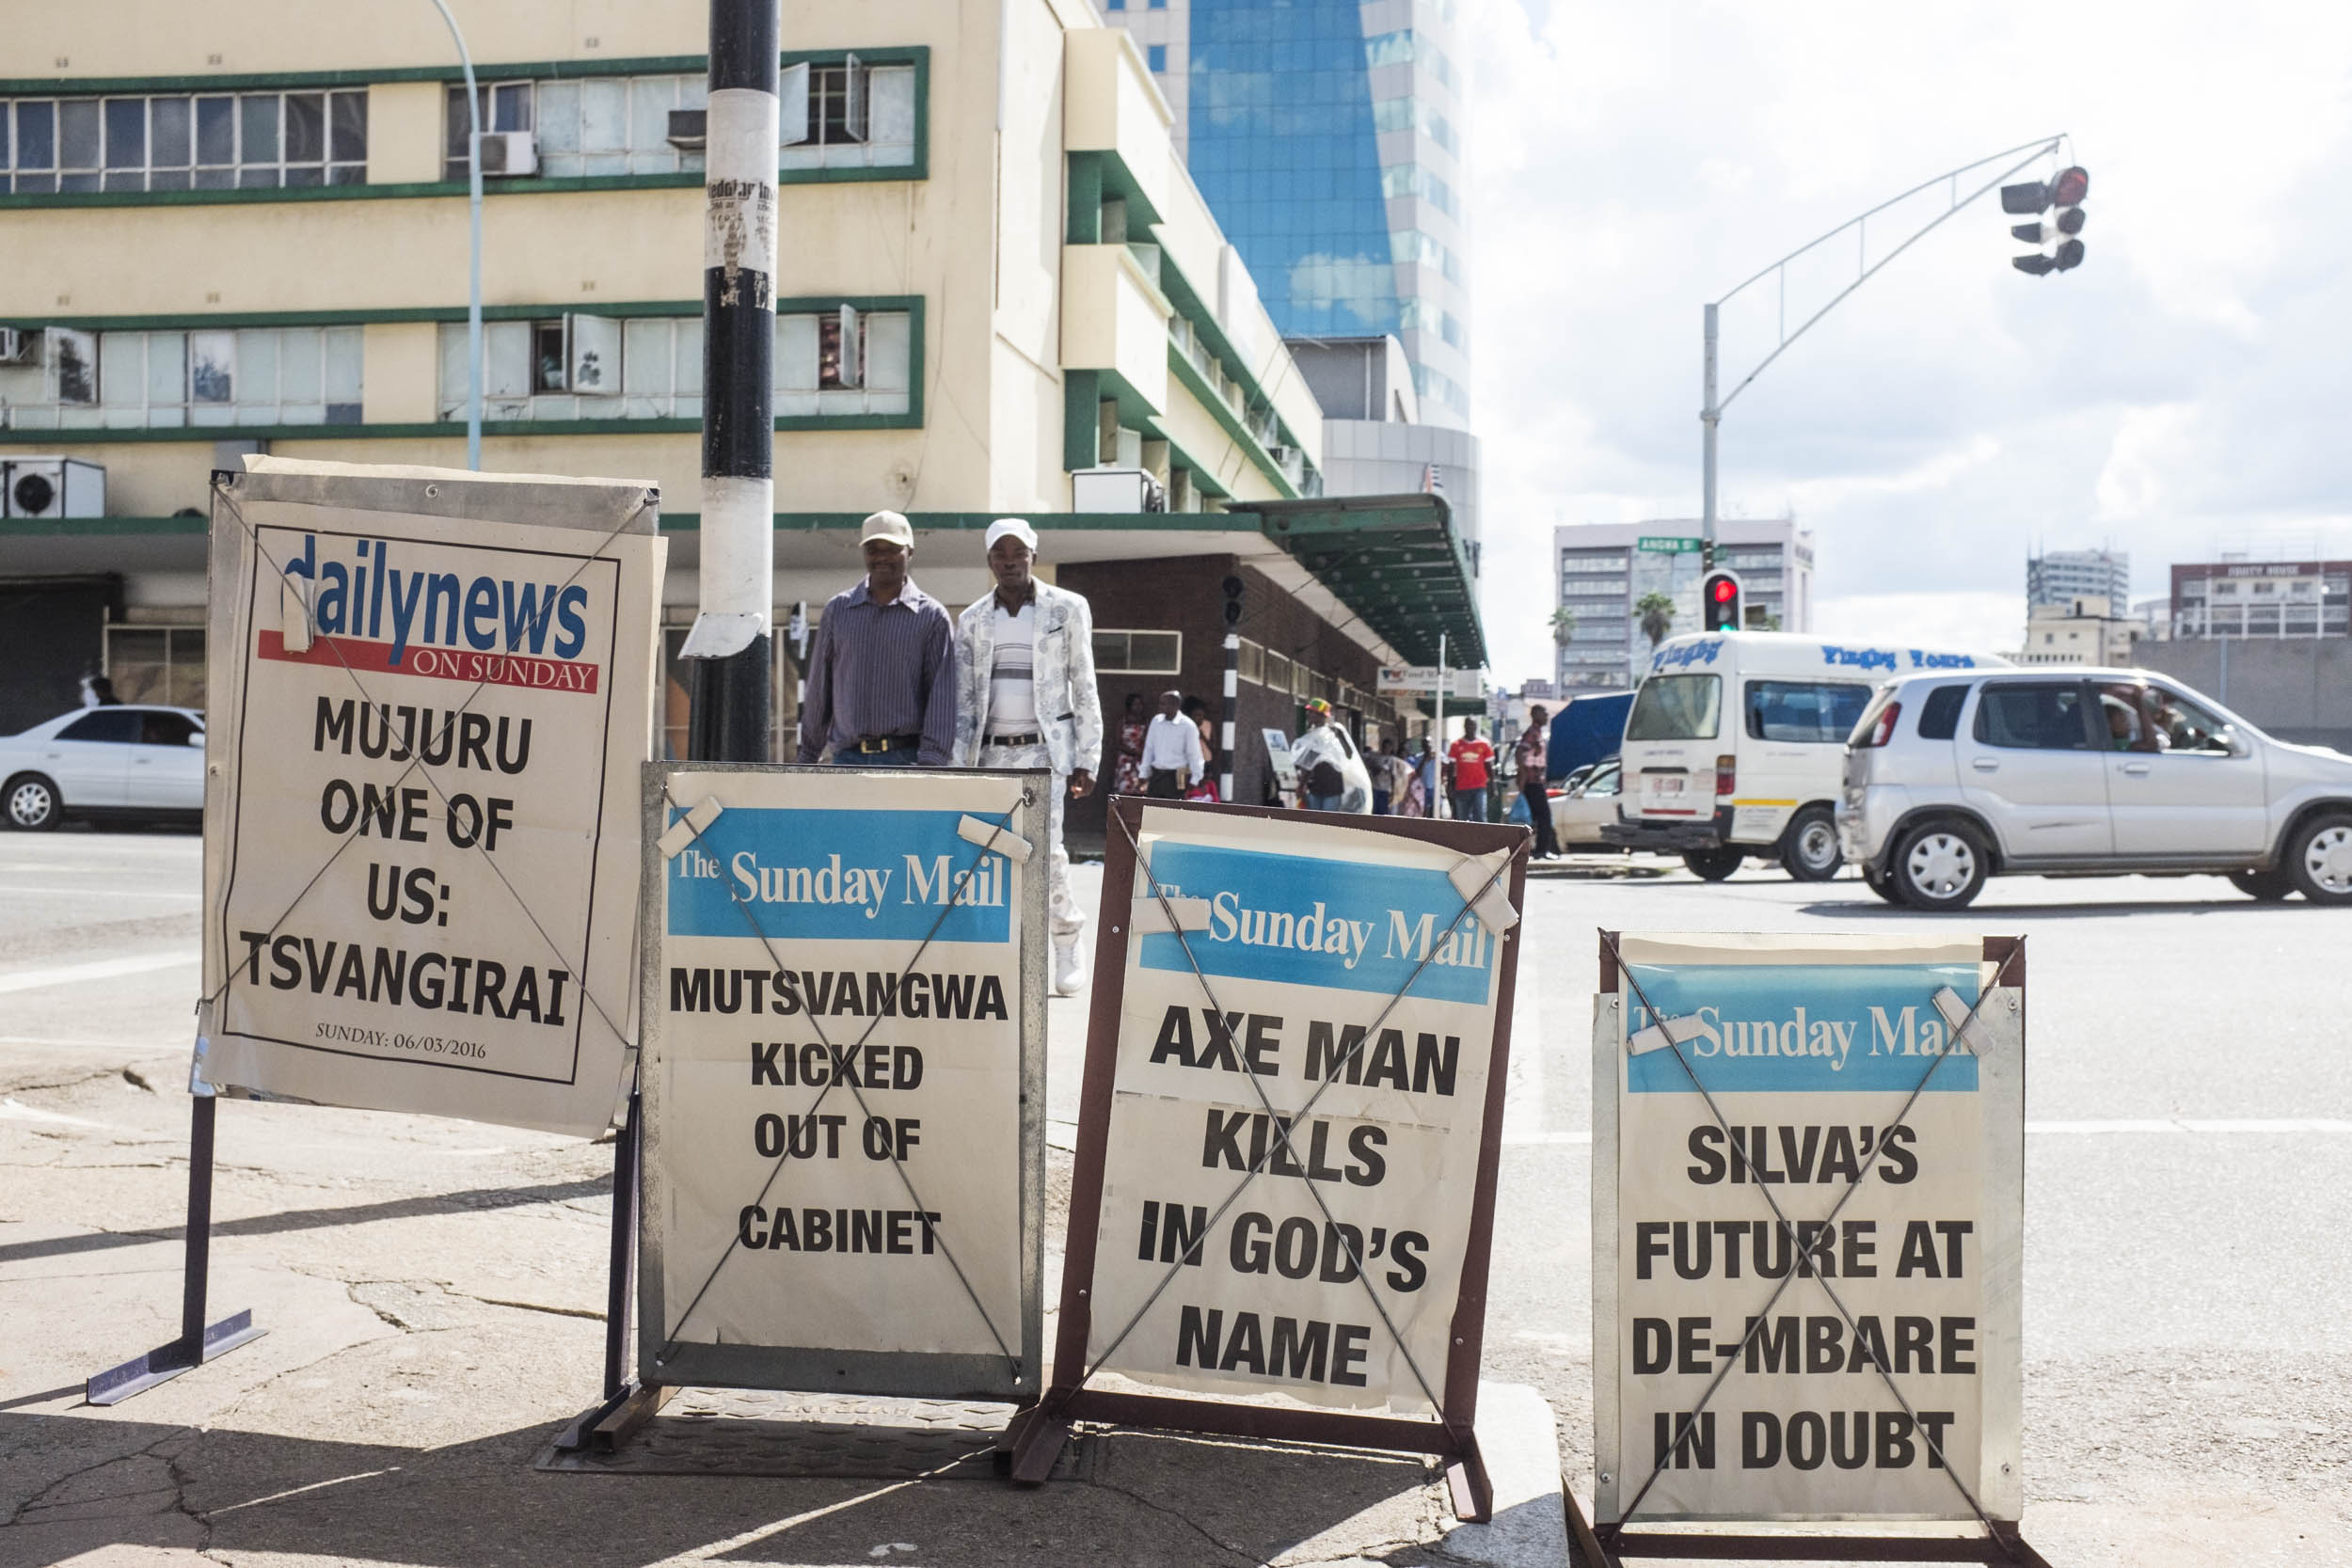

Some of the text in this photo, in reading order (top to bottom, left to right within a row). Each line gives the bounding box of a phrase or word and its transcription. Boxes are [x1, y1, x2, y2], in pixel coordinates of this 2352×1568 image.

[413, 650, 595, 690] ON SUNDAY
[313, 696, 532, 774] MUJURU
[321, 779, 514, 851] ONE OF
[367, 863, 451, 927] US:
[678, 849, 1005, 919] The Sunday Mail
[1208, 891, 1486, 970] Sunday Mail
[239, 930, 569, 1027] TSVANGIRAI
[670, 967, 1009, 1021] MUTSVANGWA
[315, 1022, 486, 1059] SUNDAY: 06/03/2016
[751, 1042, 924, 1090] KICKED
[1149, 1005, 1461, 1097] AXE MAN
[1693, 1006, 1858, 1071] Sunday
[755, 1113, 921, 1161] OUT OF
[1201, 1108, 1389, 1187] KILLS
[1687, 1124, 1918, 1185] SILVA'S
[739, 1205, 942, 1255] CABINET
[1137, 1200, 1430, 1293] IN GOD'S
[1635, 1220, 1974, 1280] FUTURE AT
[1175, 1305, 1372, 1387] NAME
[1632, 1315, 1977, 1375] DE-MBARE
[1653, 1410, 1955, 1471] IN DOUBT
